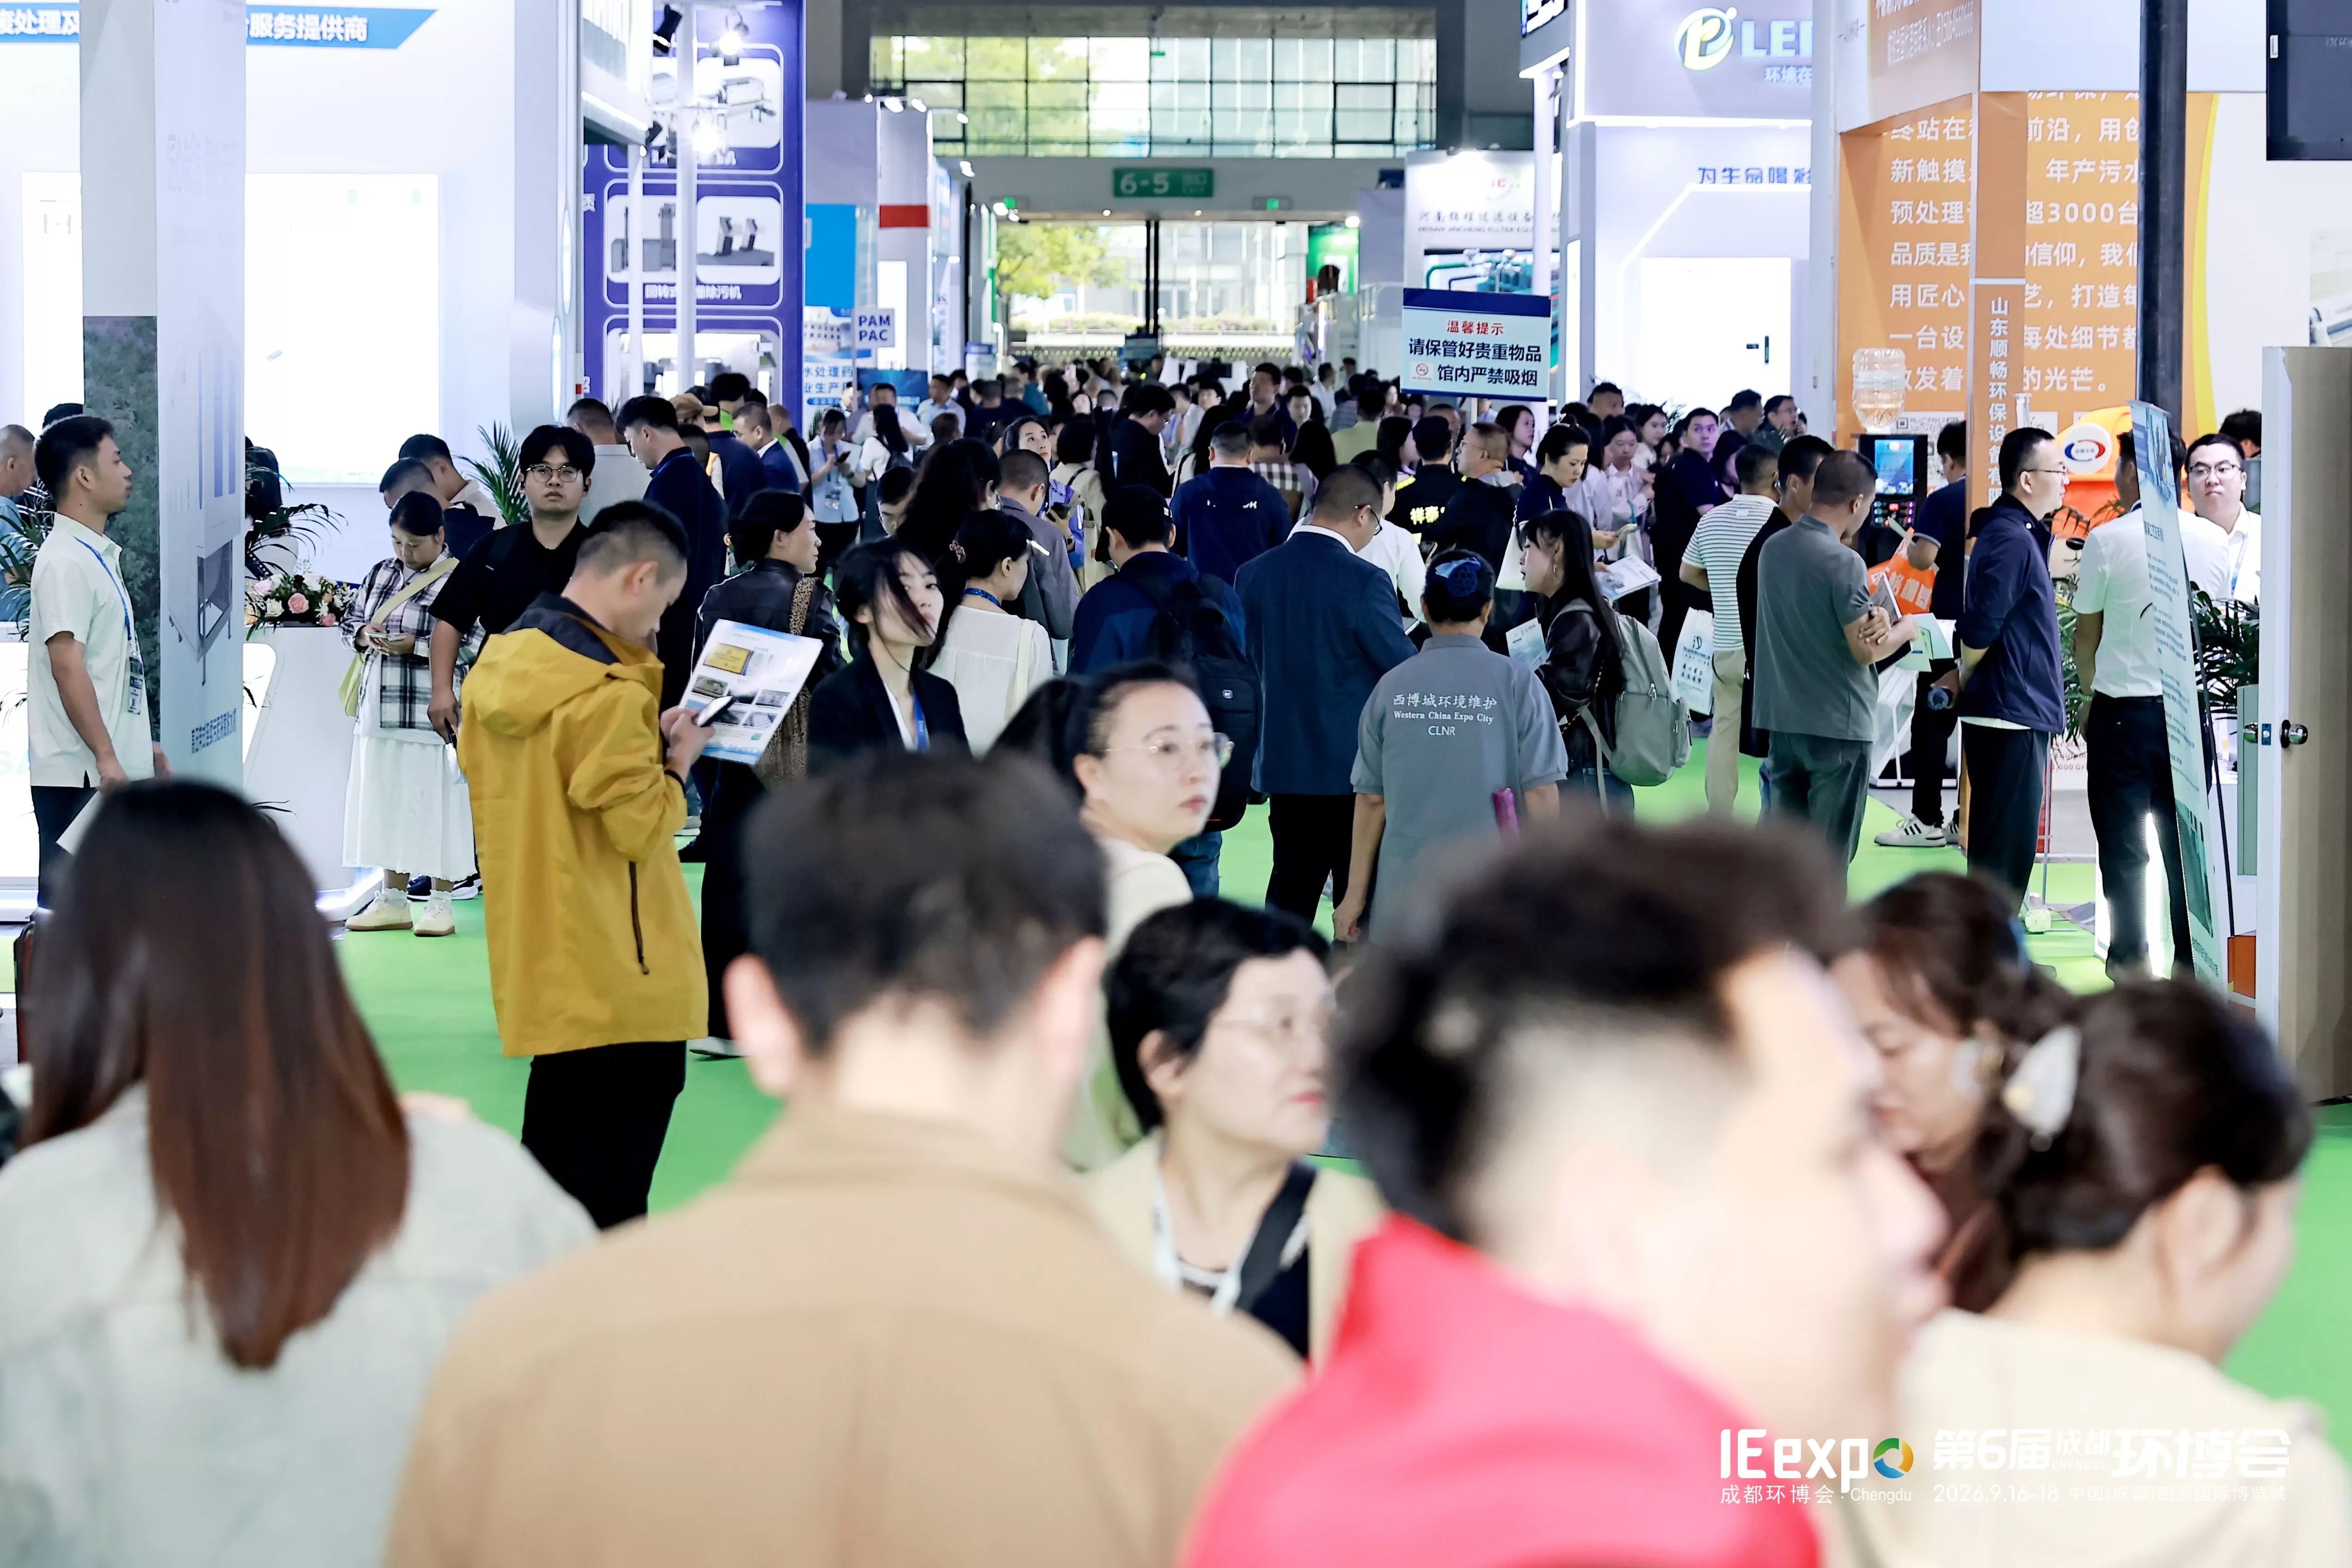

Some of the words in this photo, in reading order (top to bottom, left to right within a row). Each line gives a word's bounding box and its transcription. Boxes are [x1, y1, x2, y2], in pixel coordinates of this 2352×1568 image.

[245, 12, 368, 42] 服务提供商
[1890, 116, 1972, 141] 终站在
[1890, 158, 1972, 183] 新触摸
[1120, 172, 1169, 194] 6-5
[1890, 200, 1971, 225] 预处理
[1889, 283, 1966, 308] 用匠心
[859, 314, 890, 326] PAM
[1447, 320, 1504, 336] 温馨提示
[859, 329, 888, 342] PAC
[1889, 324, 1965, 350] 一台设
[1409, 337, 1542, 362] 请保管好贵重物品
[1437, 364, 1538, 386] 馆内严禁吸烟
[804, 382, 847, 393] 业生产
[1410, 506, 1446, 525] 祥泰
[1393, 692, 1497, 710] 西博城环境维护
[1393, 710, 1425, 720] Western
[1428, 711, 1452, 720] China
[1453, 711, 1474, 723] Expo
[1476, 713, 1494, 725] City
[1427, 725, 1456, 736] CLNR
